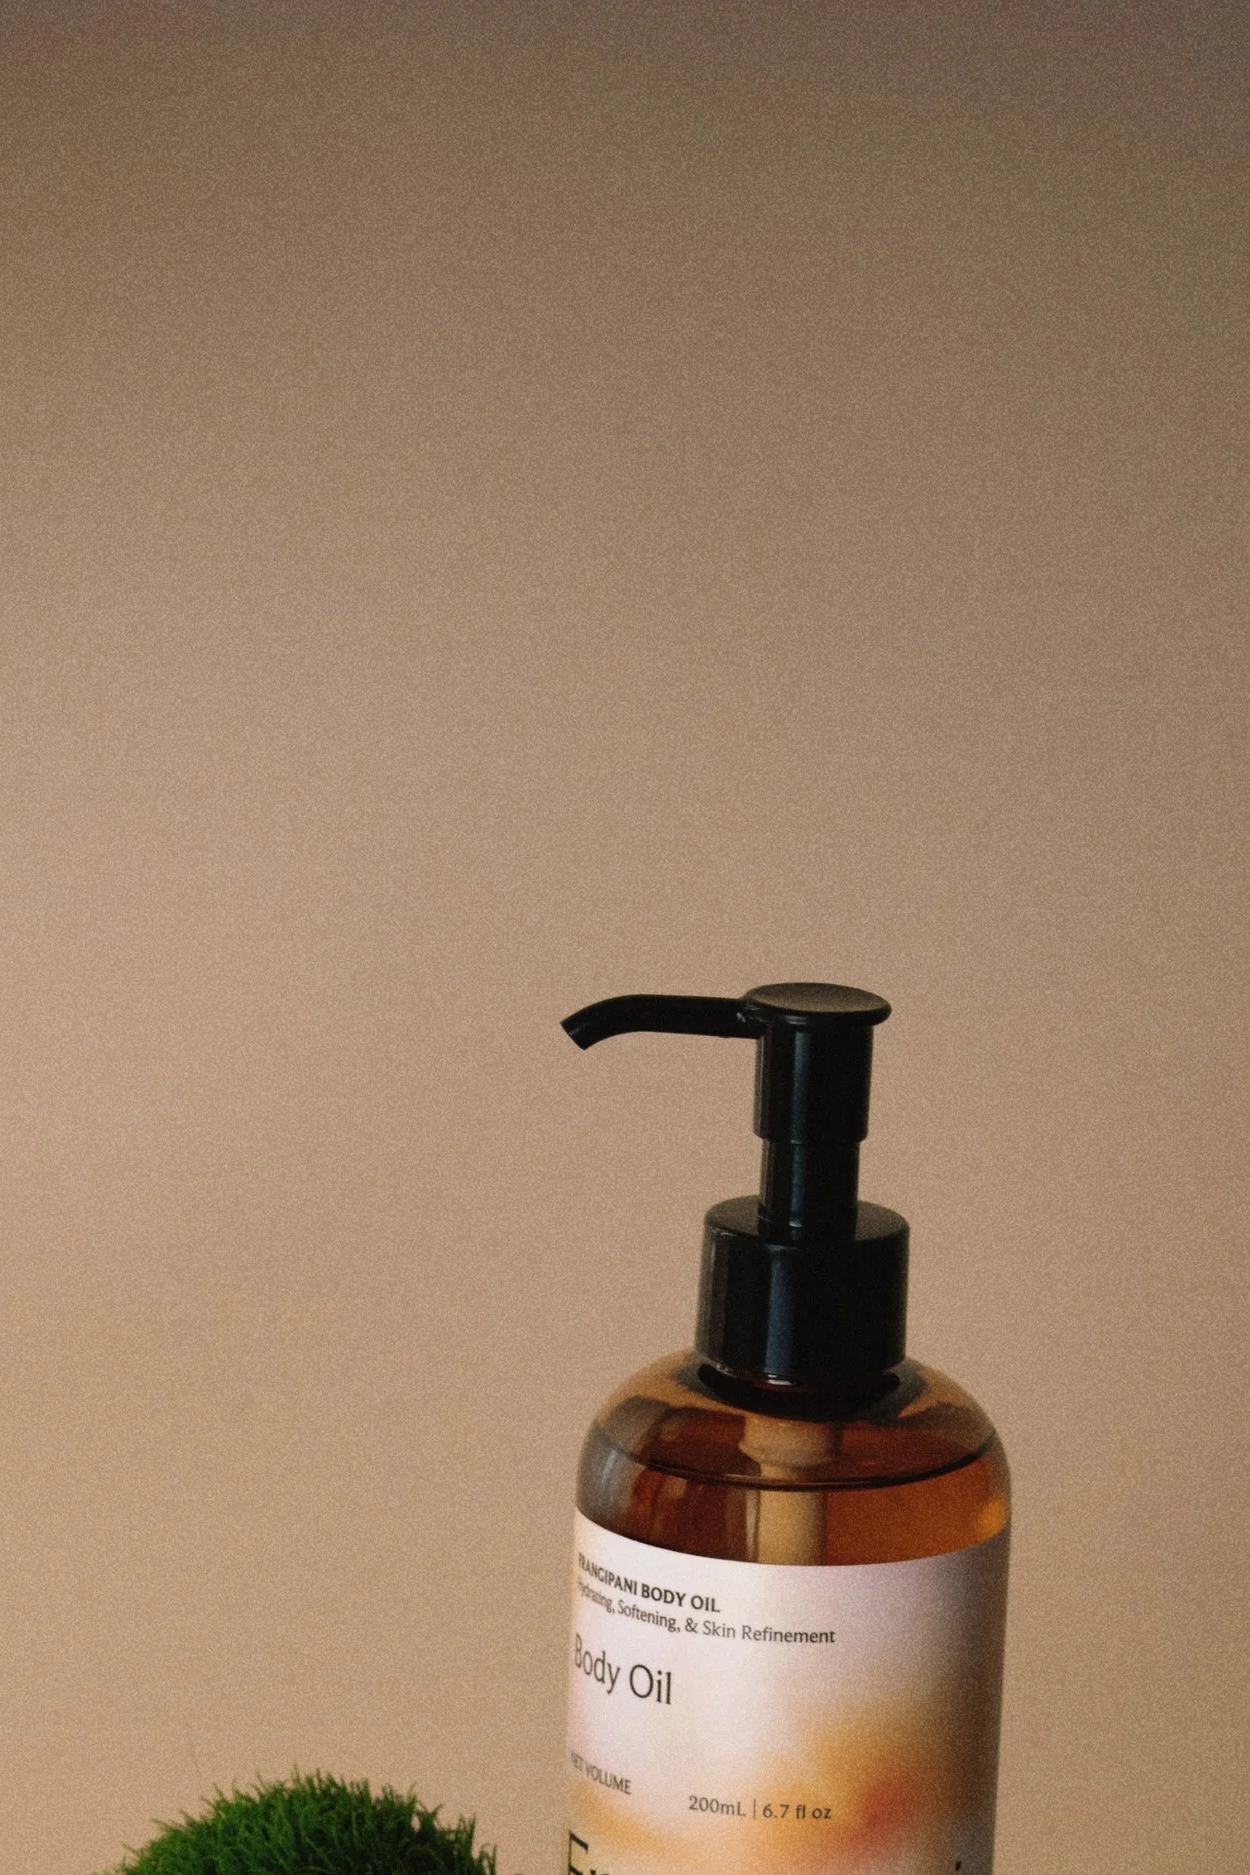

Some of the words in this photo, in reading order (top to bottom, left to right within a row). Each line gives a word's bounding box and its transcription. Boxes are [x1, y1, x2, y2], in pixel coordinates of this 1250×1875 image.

[578, 1552, 638, 1595] FRANGIPANI
[641, 1583, 686, 1606] BODY
[690, 1594, 720, 1613] OIL
[618, 1599, 681, 1633] Softening,
[685, 1617, 698, 1633] &
[702, 1620, 736, 1638] Skin
[741, 1625, 837, 1643] Refinement
[575, 1633, 620, 1694] Body
[629, 1664, 672, 1705] Oil
[585, 1761, 632, 1795] VOLUME
[688, 1795, 746, 1817] 200mL
[762, 1804, 790, 1819] 6.7
[795, 1803, 806, 1820] fl
[811, 1807, 831, 1819] oz
